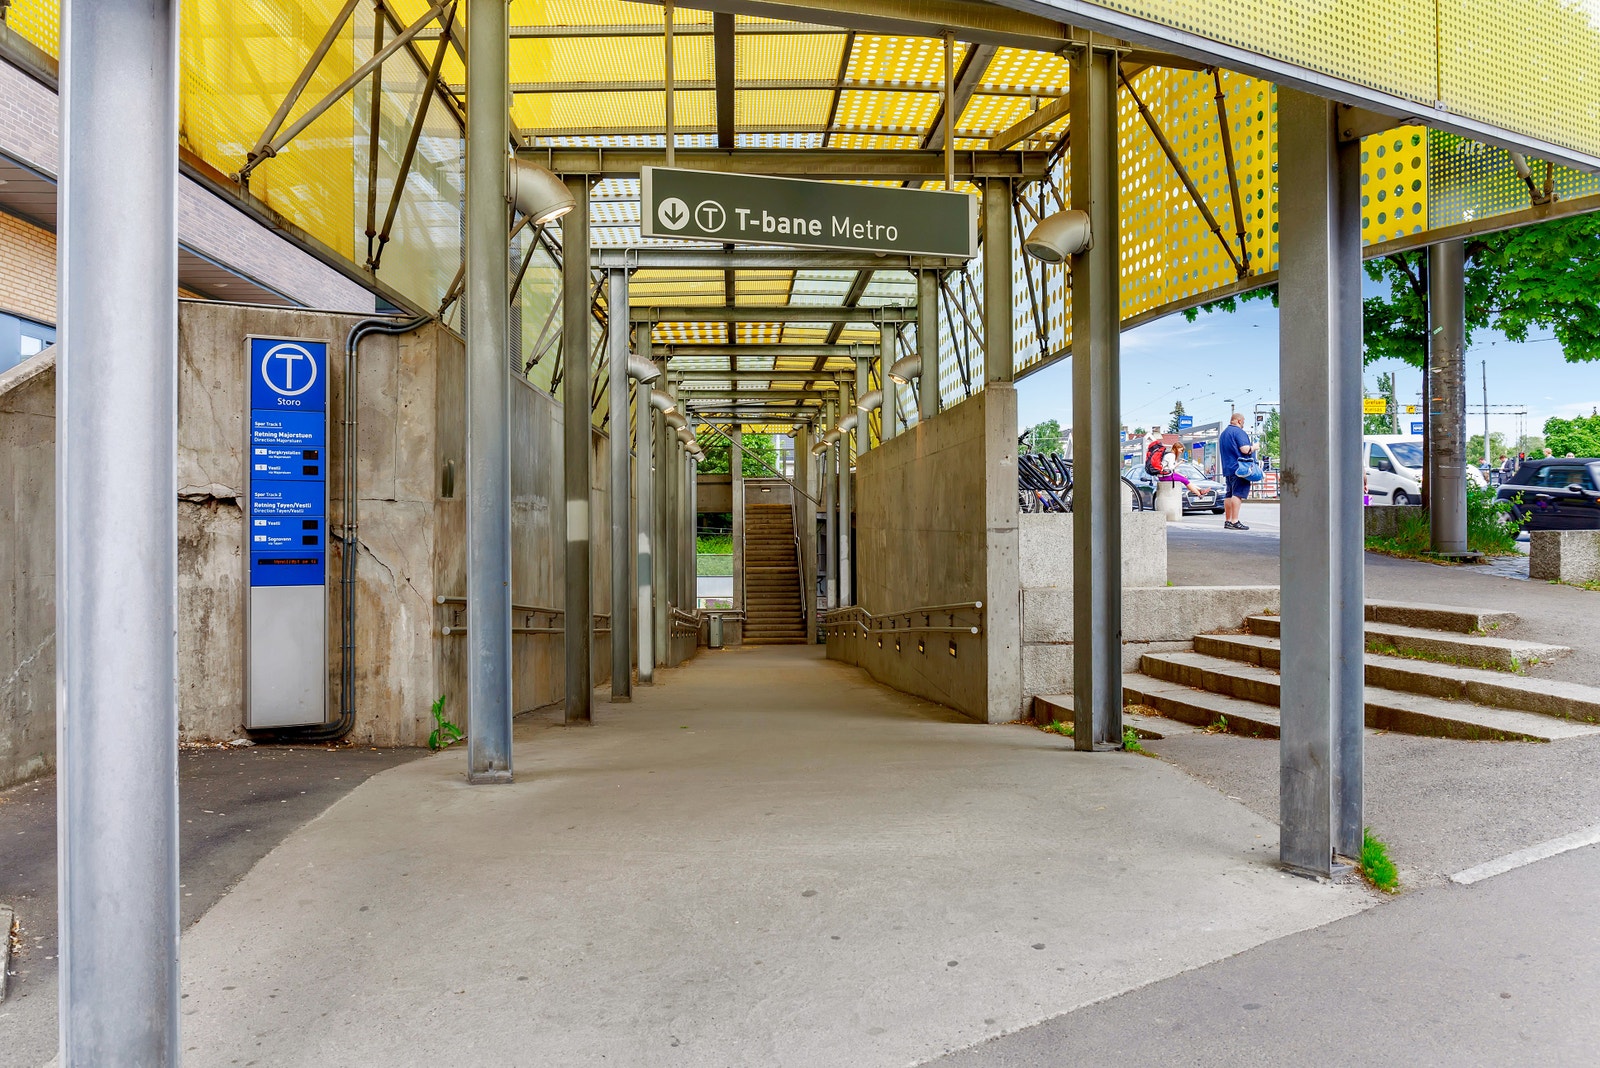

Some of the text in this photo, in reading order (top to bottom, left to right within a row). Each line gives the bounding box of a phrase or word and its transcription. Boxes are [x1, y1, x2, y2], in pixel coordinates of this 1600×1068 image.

[735, 208, 822, 236] T-bane
[831, 216, 898, 242] Metro
[276, 353, 303, 389] T
[277, 397, 301, 406] Storo
